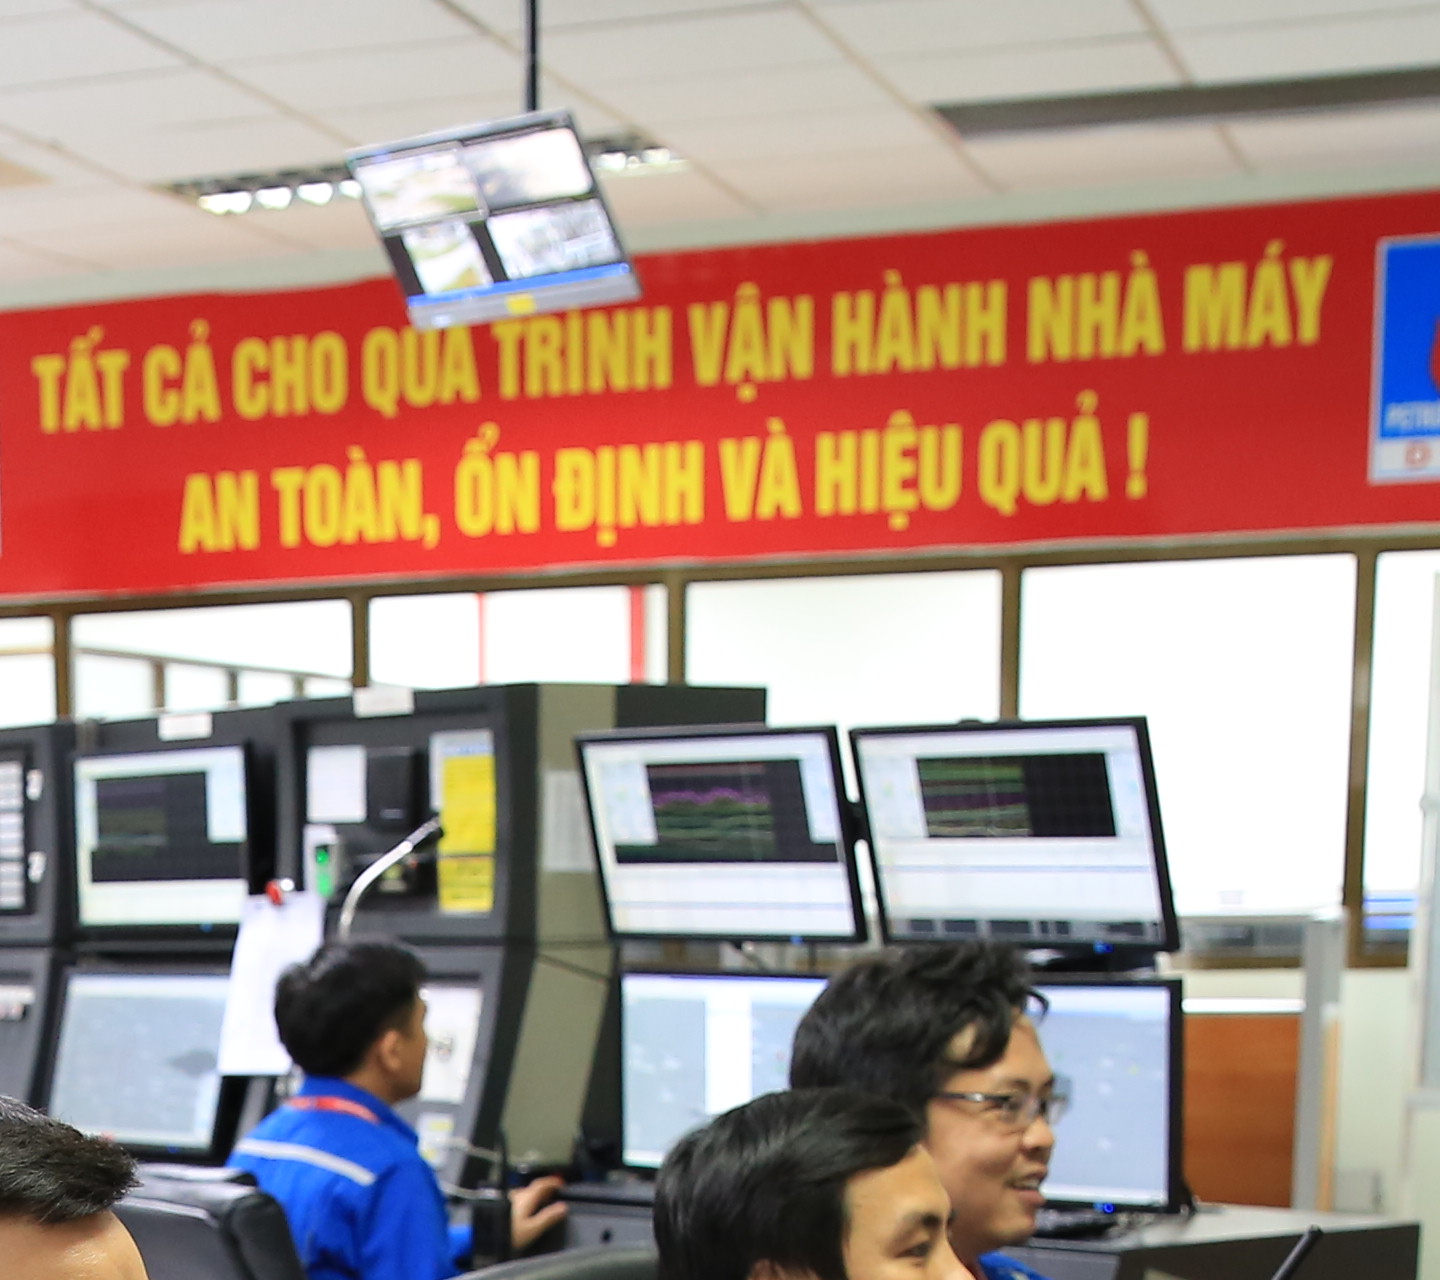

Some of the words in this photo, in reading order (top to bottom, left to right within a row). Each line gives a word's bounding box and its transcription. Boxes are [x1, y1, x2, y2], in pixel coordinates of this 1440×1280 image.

[31, 325, 129, 434] TẤT
[142, 319, 220, 428] CẢ
[232, 330, 348, 420] CHO
[689, 281, 814, 402] VẬN
[831, 269, 1007, 377] HÀNH
[1027, 250, 1163, 363] NHÀ
[1182, 240, 1332, 355] MÁY
[178, 472, 260, 554] AN
[272, 446, 441, 551] TOÀN,
[454, 421, 540, 537] ỔN
[553, 440, 704, 547] ĐỊNH
[720, 416, 802, 521] VÀ
[815, 410, 963, 531] HIỆU
[977, 388, 1108, 516] QUẢ
[1125, 412, 1149, 499] !
